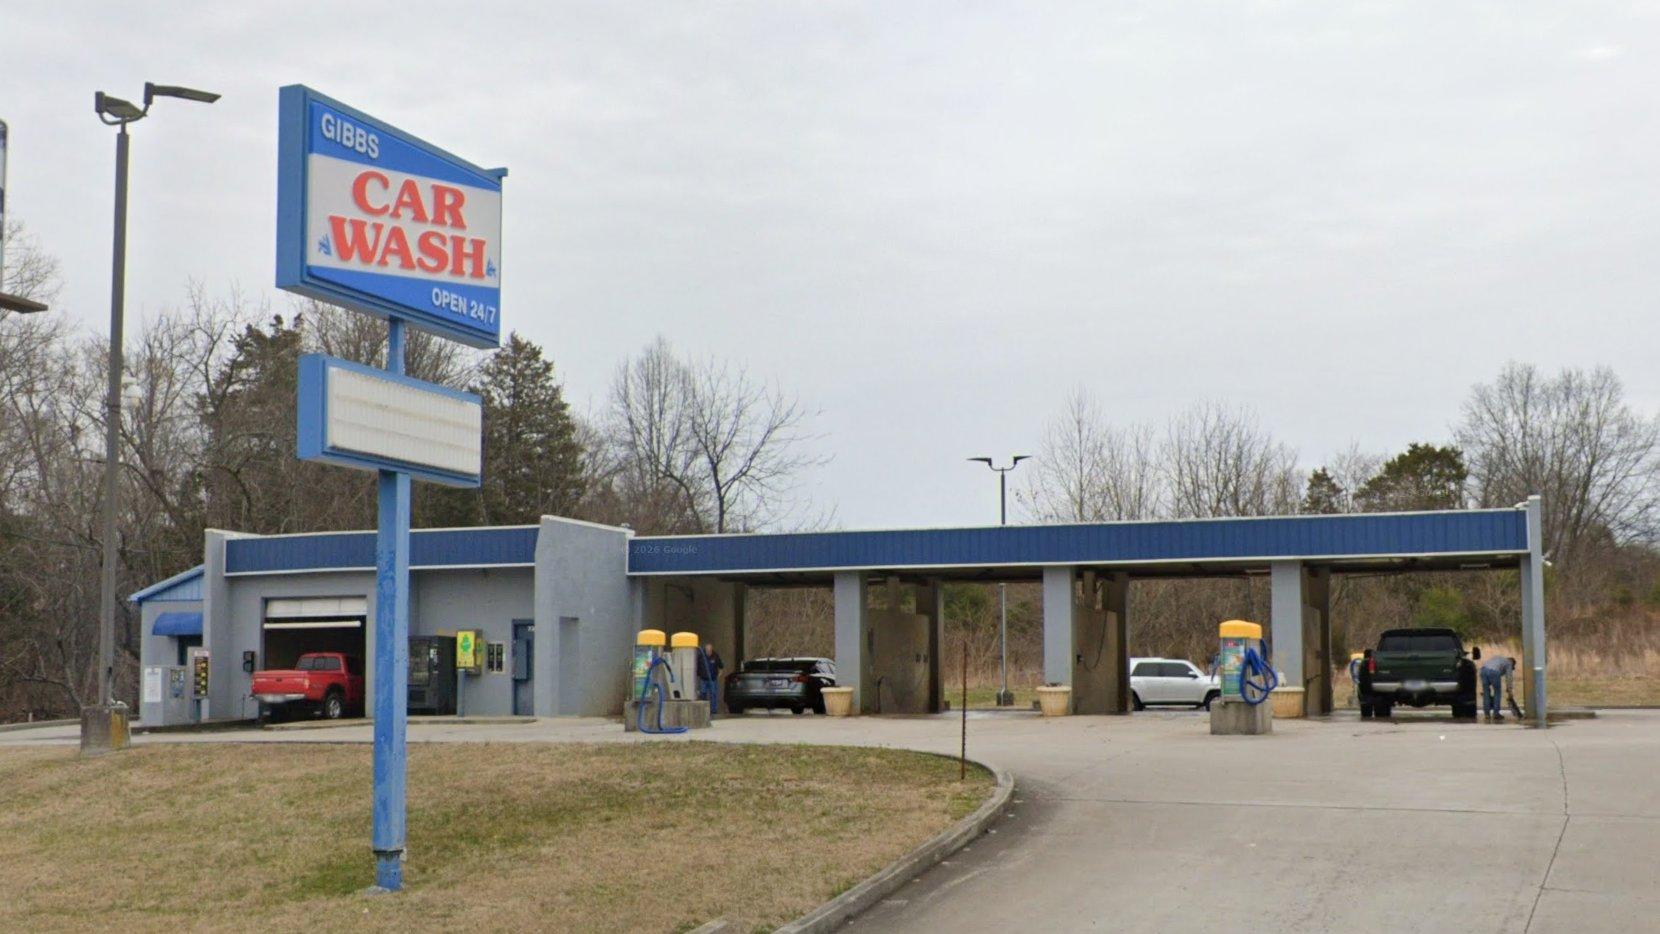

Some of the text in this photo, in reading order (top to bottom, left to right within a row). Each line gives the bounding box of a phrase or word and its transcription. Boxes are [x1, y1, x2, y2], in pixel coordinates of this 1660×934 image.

[321, 112, 379, 159] GIBBS
[352, 170, 468, 230] CAR
[328, 215, 486, 279] WASH
[432, 287, 496, 324] OPEN 24/7
